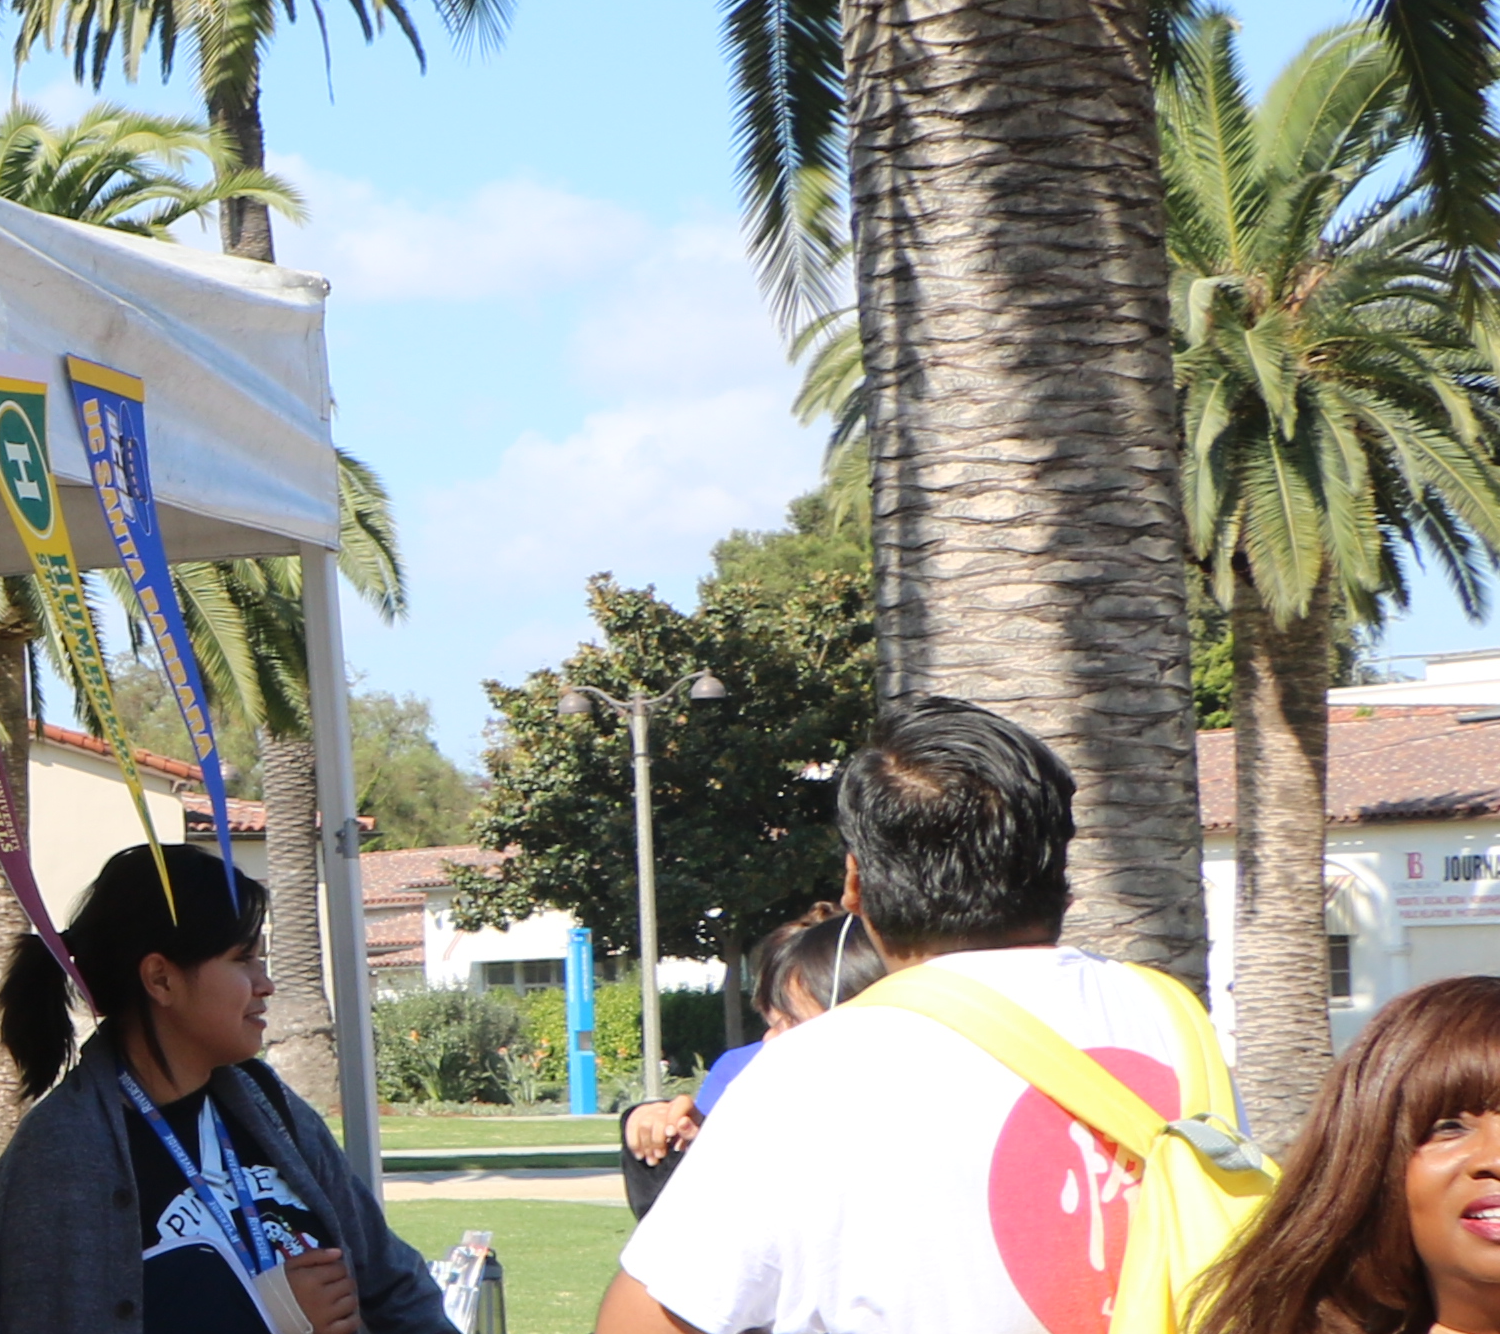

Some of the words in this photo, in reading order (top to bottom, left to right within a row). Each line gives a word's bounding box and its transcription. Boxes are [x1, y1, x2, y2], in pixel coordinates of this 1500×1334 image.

[4, 440, 42, 502] H
[83, 398, 105, 454] UC
[95, 459, 145, 584] SANTA
[139, 586, 213, 762] BARBARA
[119, 1071, 153, 1114] RIVERSIDE
[166, 1134, 198, 1177] RIVERSIDE
[225, 1148, 246, 1191] RIVERSIDE
[208, 1201, 240, 1244] RIVERSIDE
[249, 1217, 271, 1261] RIVERSIDE
